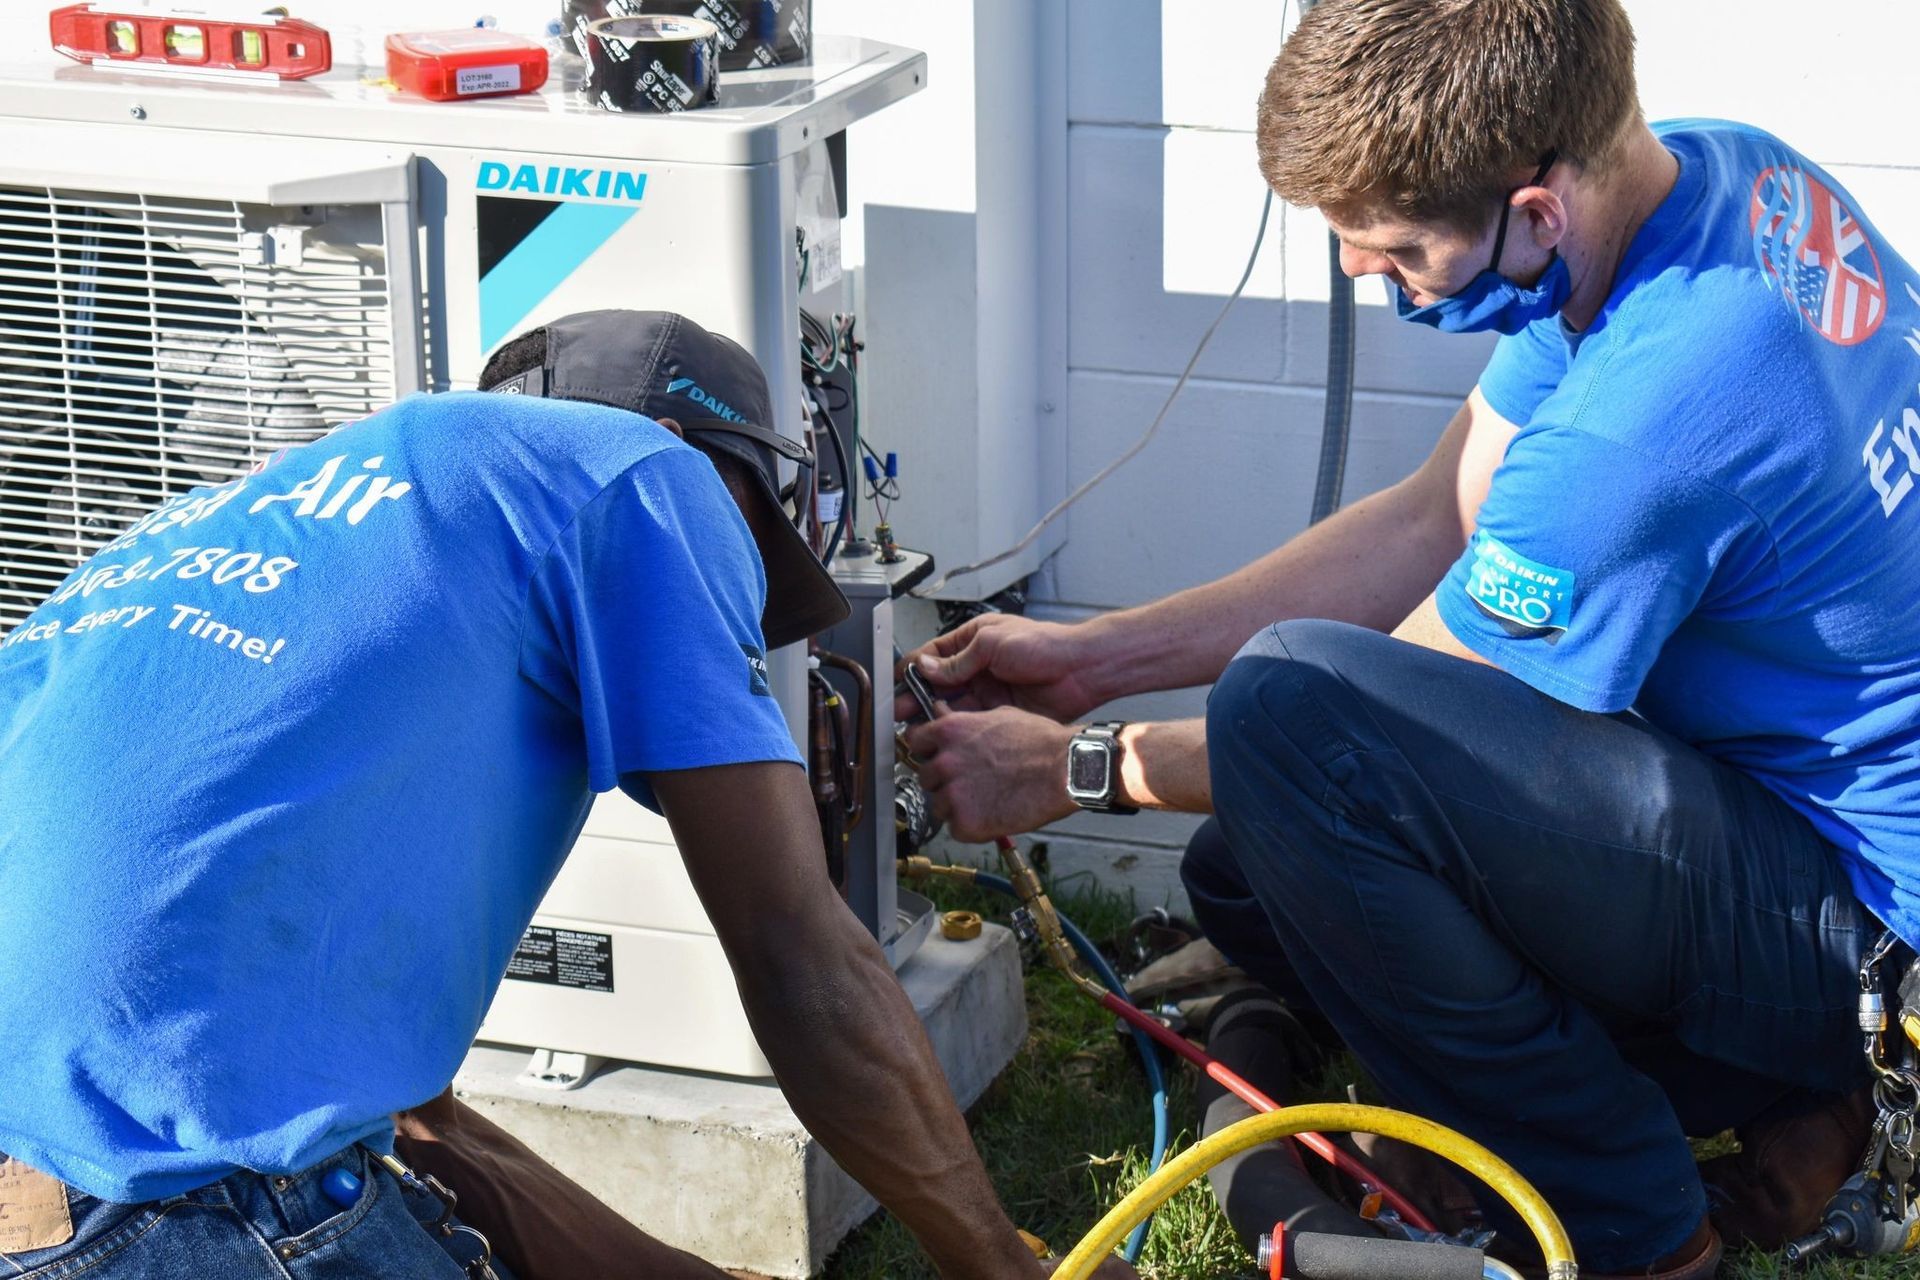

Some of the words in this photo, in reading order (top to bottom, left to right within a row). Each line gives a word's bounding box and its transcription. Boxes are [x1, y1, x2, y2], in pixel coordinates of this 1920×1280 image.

[476, 161, 647, 201] DAIKIN
[248, 454, 411, 525] Air
[1494, 552, 1559, 587] DAIKIN
[1478, 571, 1552, 624] PRO
[64, 605, 157, 634] Every
[168, 604, 286, 664] Time!
